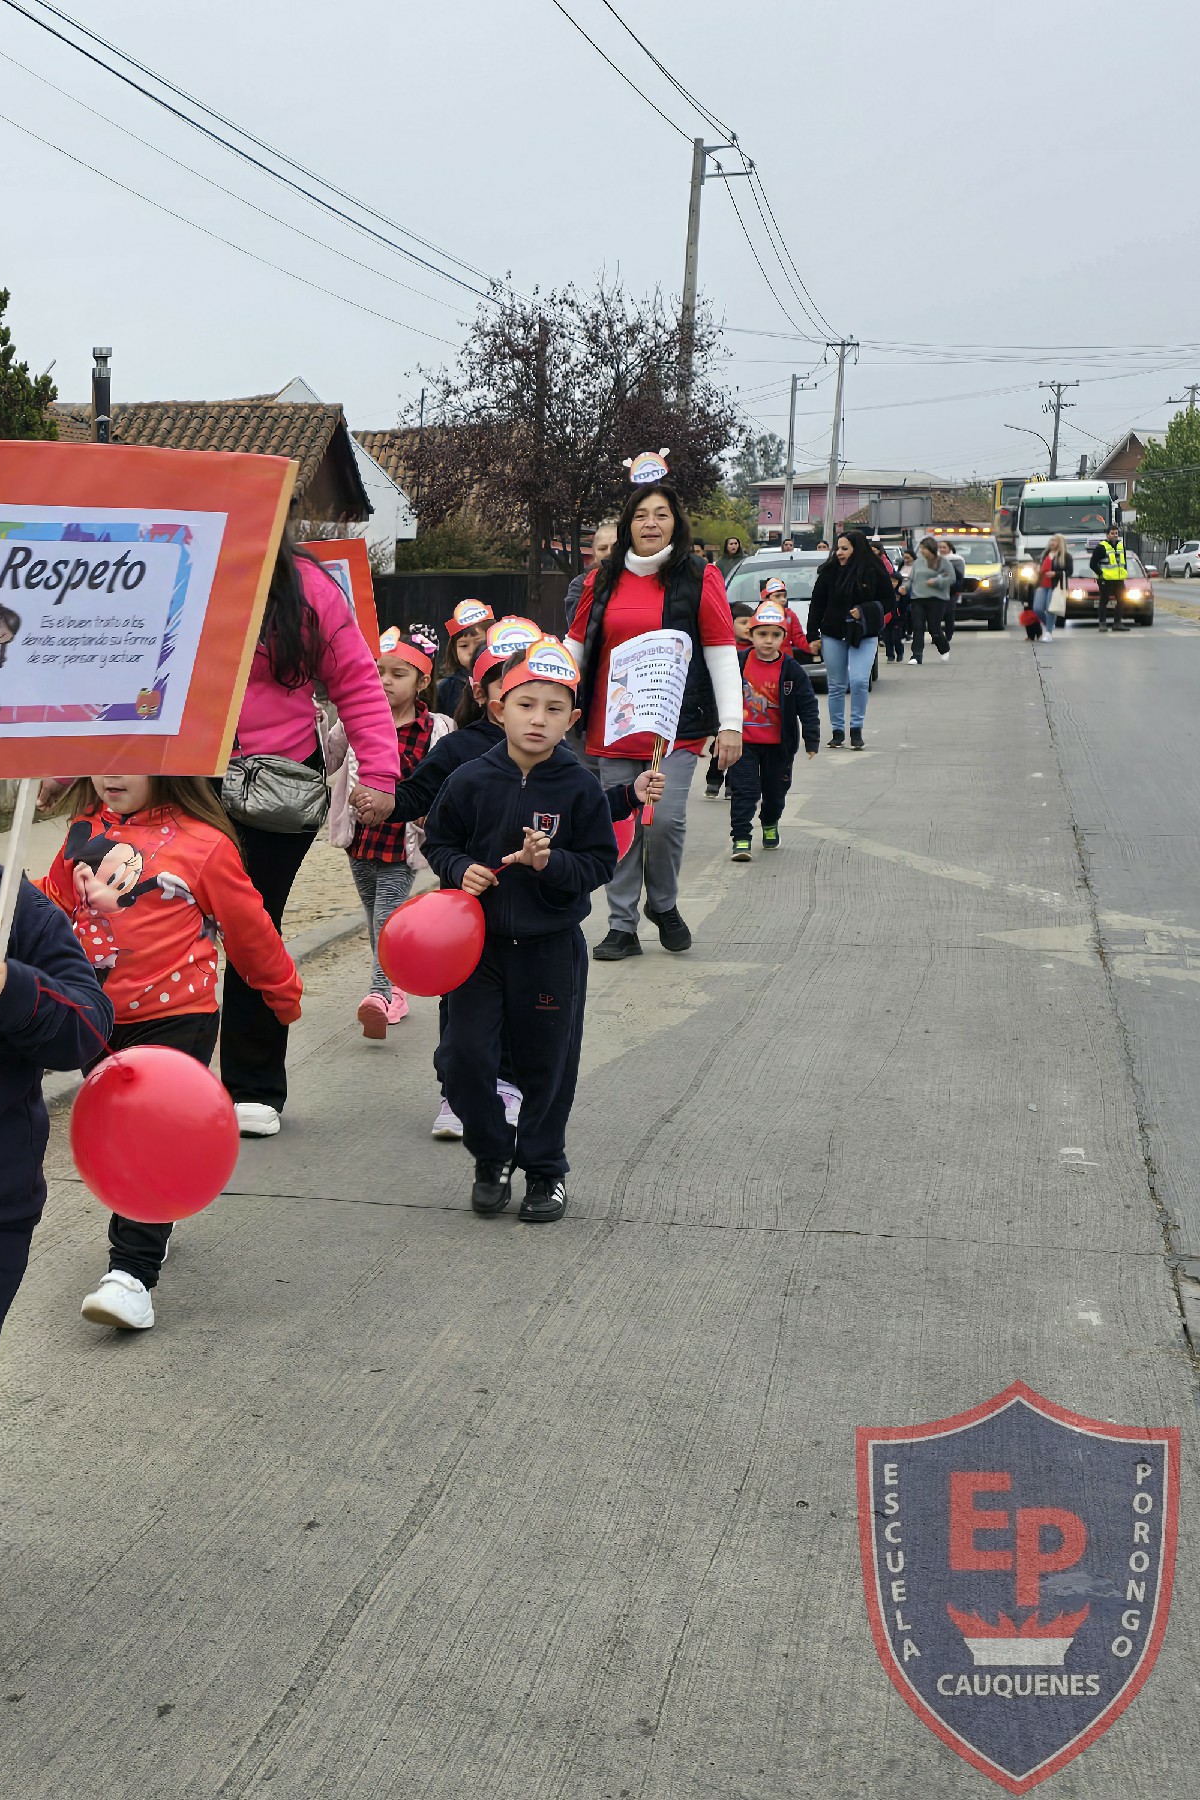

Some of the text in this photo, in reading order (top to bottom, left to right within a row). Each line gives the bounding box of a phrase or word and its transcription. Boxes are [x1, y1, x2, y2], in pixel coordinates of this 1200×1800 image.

[40, 614, 55, 629] Es
[123, 631, 157, 646] forma
[492, 641, 534, 654] RESPE
[108, 650, 145, 663] actuar
[614, 645, 676, 670] Respeto
[528, 661, 576, 679] RESPETO
[538, 993, 554, 1005] EP
